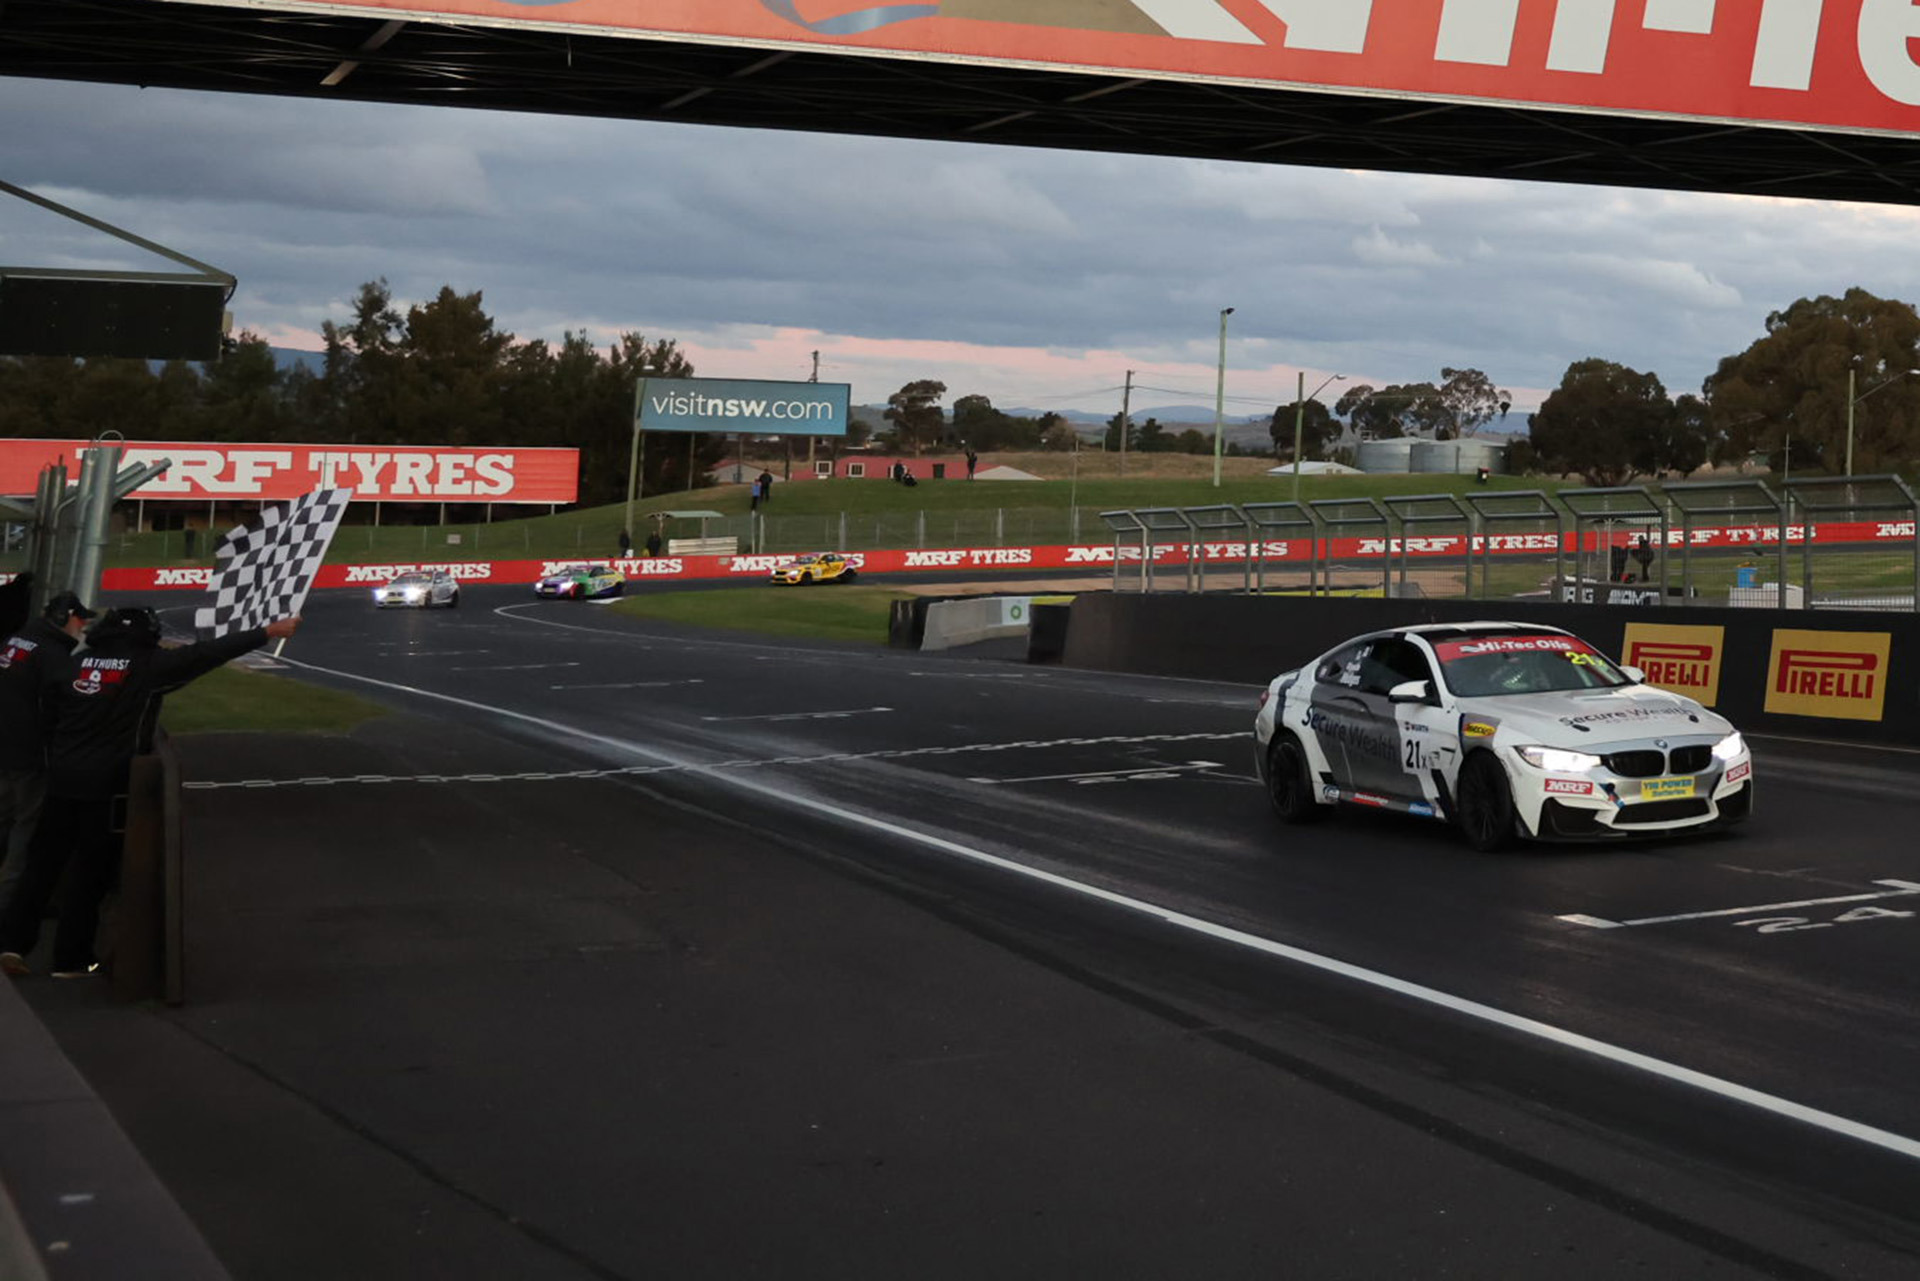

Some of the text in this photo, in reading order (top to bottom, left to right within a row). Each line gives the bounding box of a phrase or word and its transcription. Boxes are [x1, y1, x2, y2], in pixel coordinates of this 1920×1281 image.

[653, 391, 833, 419] visitnsw.com
[308, 451, 515, 496] TYRES
[1065, 541, 1288, 562] MRF TYRES
[1357, 534, 1559, 554] MRF TYRES
[614, 558, 683, 575] TYRES
[904, 549, 1032, 566] MRF TYRES
[1477, 639, 1572, 652] Hi-Tec Oils
[81, 657, 131, 670] BATHURST
[1630, 642, 1713, 688] PIRELLI
[1776, 650, 1878, 699] PIRELLI
[1301, 704, 1346, 741] Secure
[1547, 780, 1591, 793] MRF
